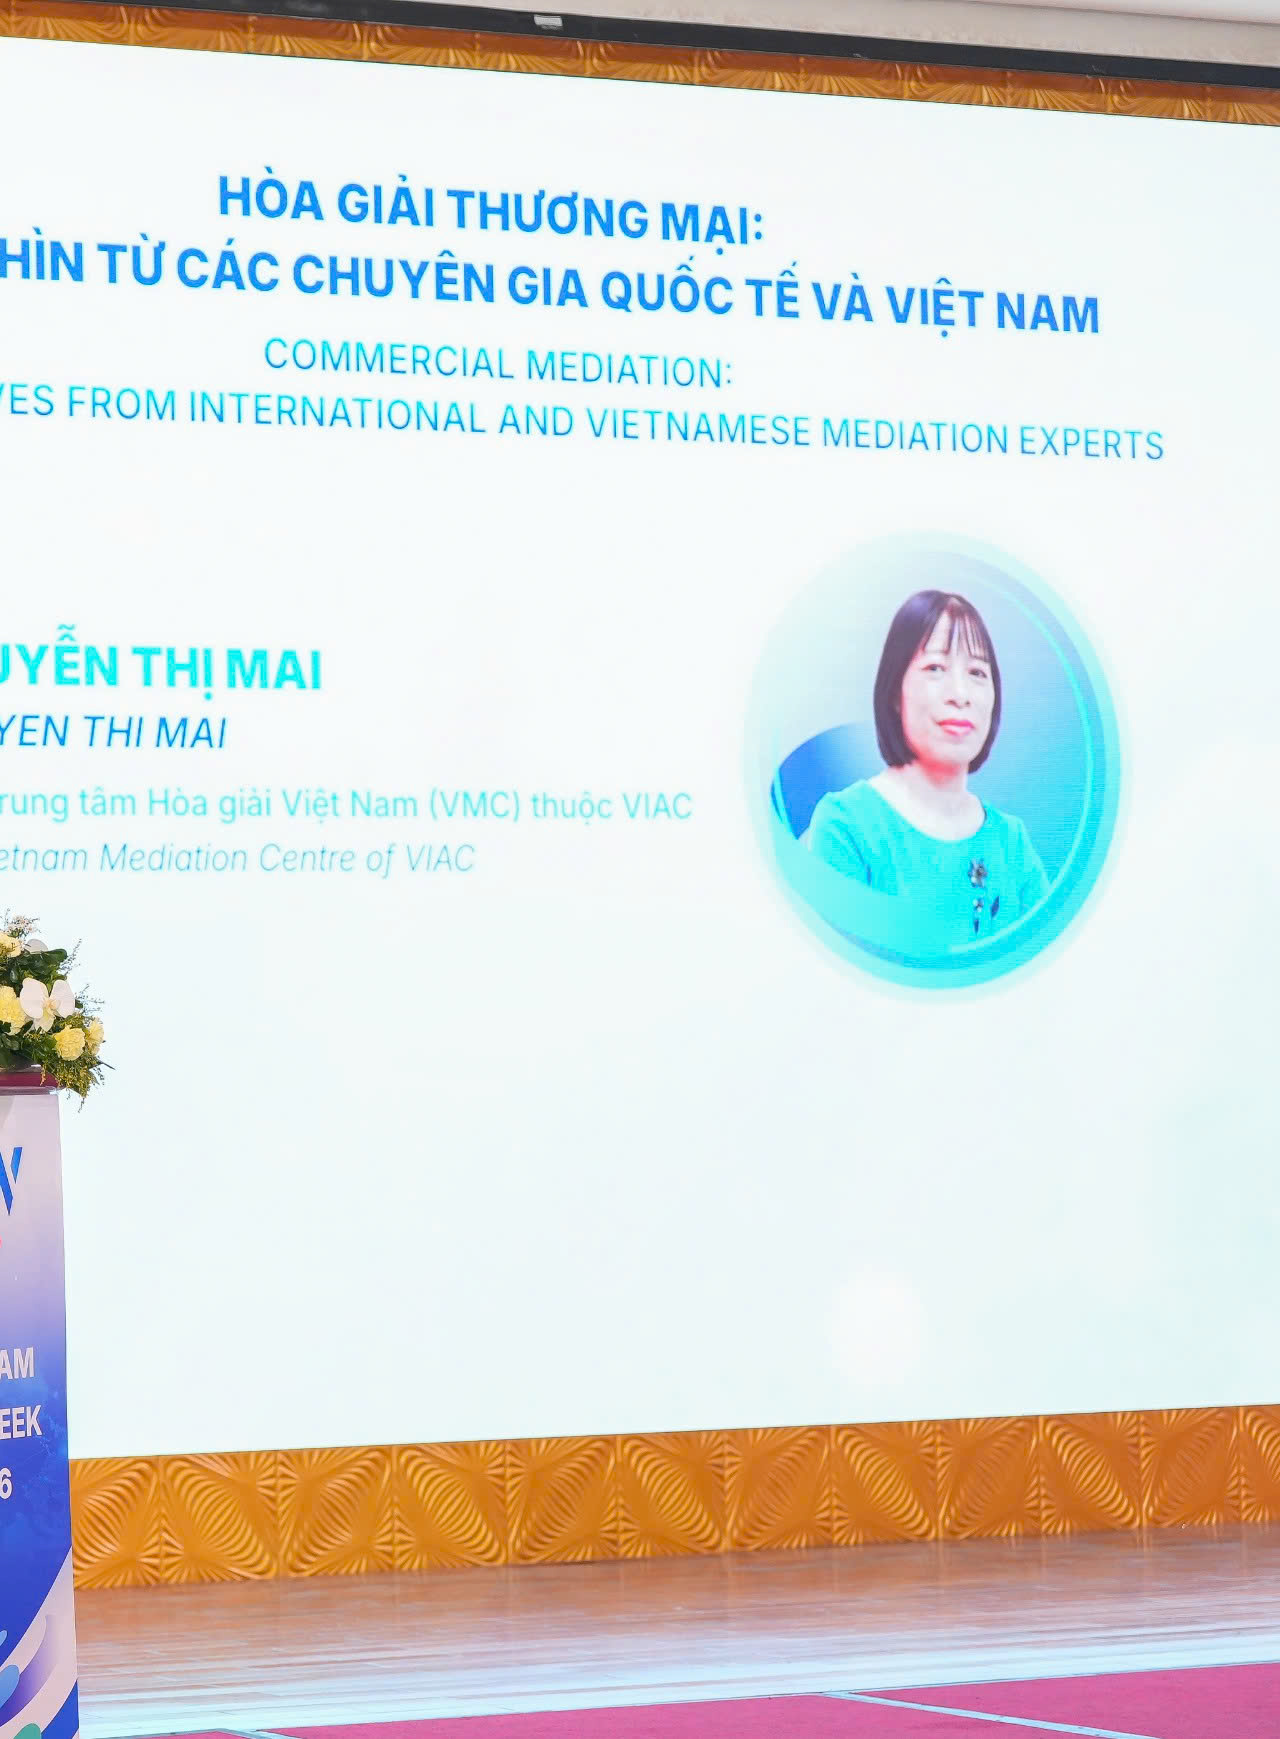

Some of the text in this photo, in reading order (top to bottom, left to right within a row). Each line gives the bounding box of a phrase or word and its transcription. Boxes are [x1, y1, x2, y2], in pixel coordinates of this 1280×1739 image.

[219, 166, 763, 256] HÒA GIẢI THƯƠNG MẠI:
[97, 233, 166, 286] TỪ
[176, 238, 280, 292] CÁC
[293, 249, 495, 303] CHUYÊN
[508, 266, 589, 308] GIA
[601, 256, 733, 315] QUỐC
[744, 261, 800, 319] TẾ
[811, 272, 874, 322] VÀ
[885, 277, 984, 339] VIỆT
[997, 292, 1099, 333] NAM
[264, 337, 732, 389] COMMERCIAL MEDIATION:
[68, 384, 176, 422] FROM
[190, 390, 488, 434] INTERNATIONAL
[498, 403, 575, 437] AND
[586, 407, 811, 447] VIETNAMESE
[822, 416, 1008, 456] MEDIATION
[1019, 424, 1164, 461] EXPERTS
[131, 646, 214, 701] THỊ
[226, 648, 321, 690] MAI
[84, 715, 144, 747] THI
[156, 717, 226, 748] MAI
[78, 786, 136, 816] tâm
[148, 787, 208, 816] Hòa
[281, 787, 340, 824] Việt
[350, 789, 418, 819] Nam
[429, 787, 520, 823] (VMC)
[530, 791, 613, 825] thuộc
[622, 792, 692, 820] VIAC
[100, 842, 248, 872] Mediation
[259, 843, 357, 873] Centre
[365, 843, 397, 880] of
[404, 843, 476, 873] VIAC
